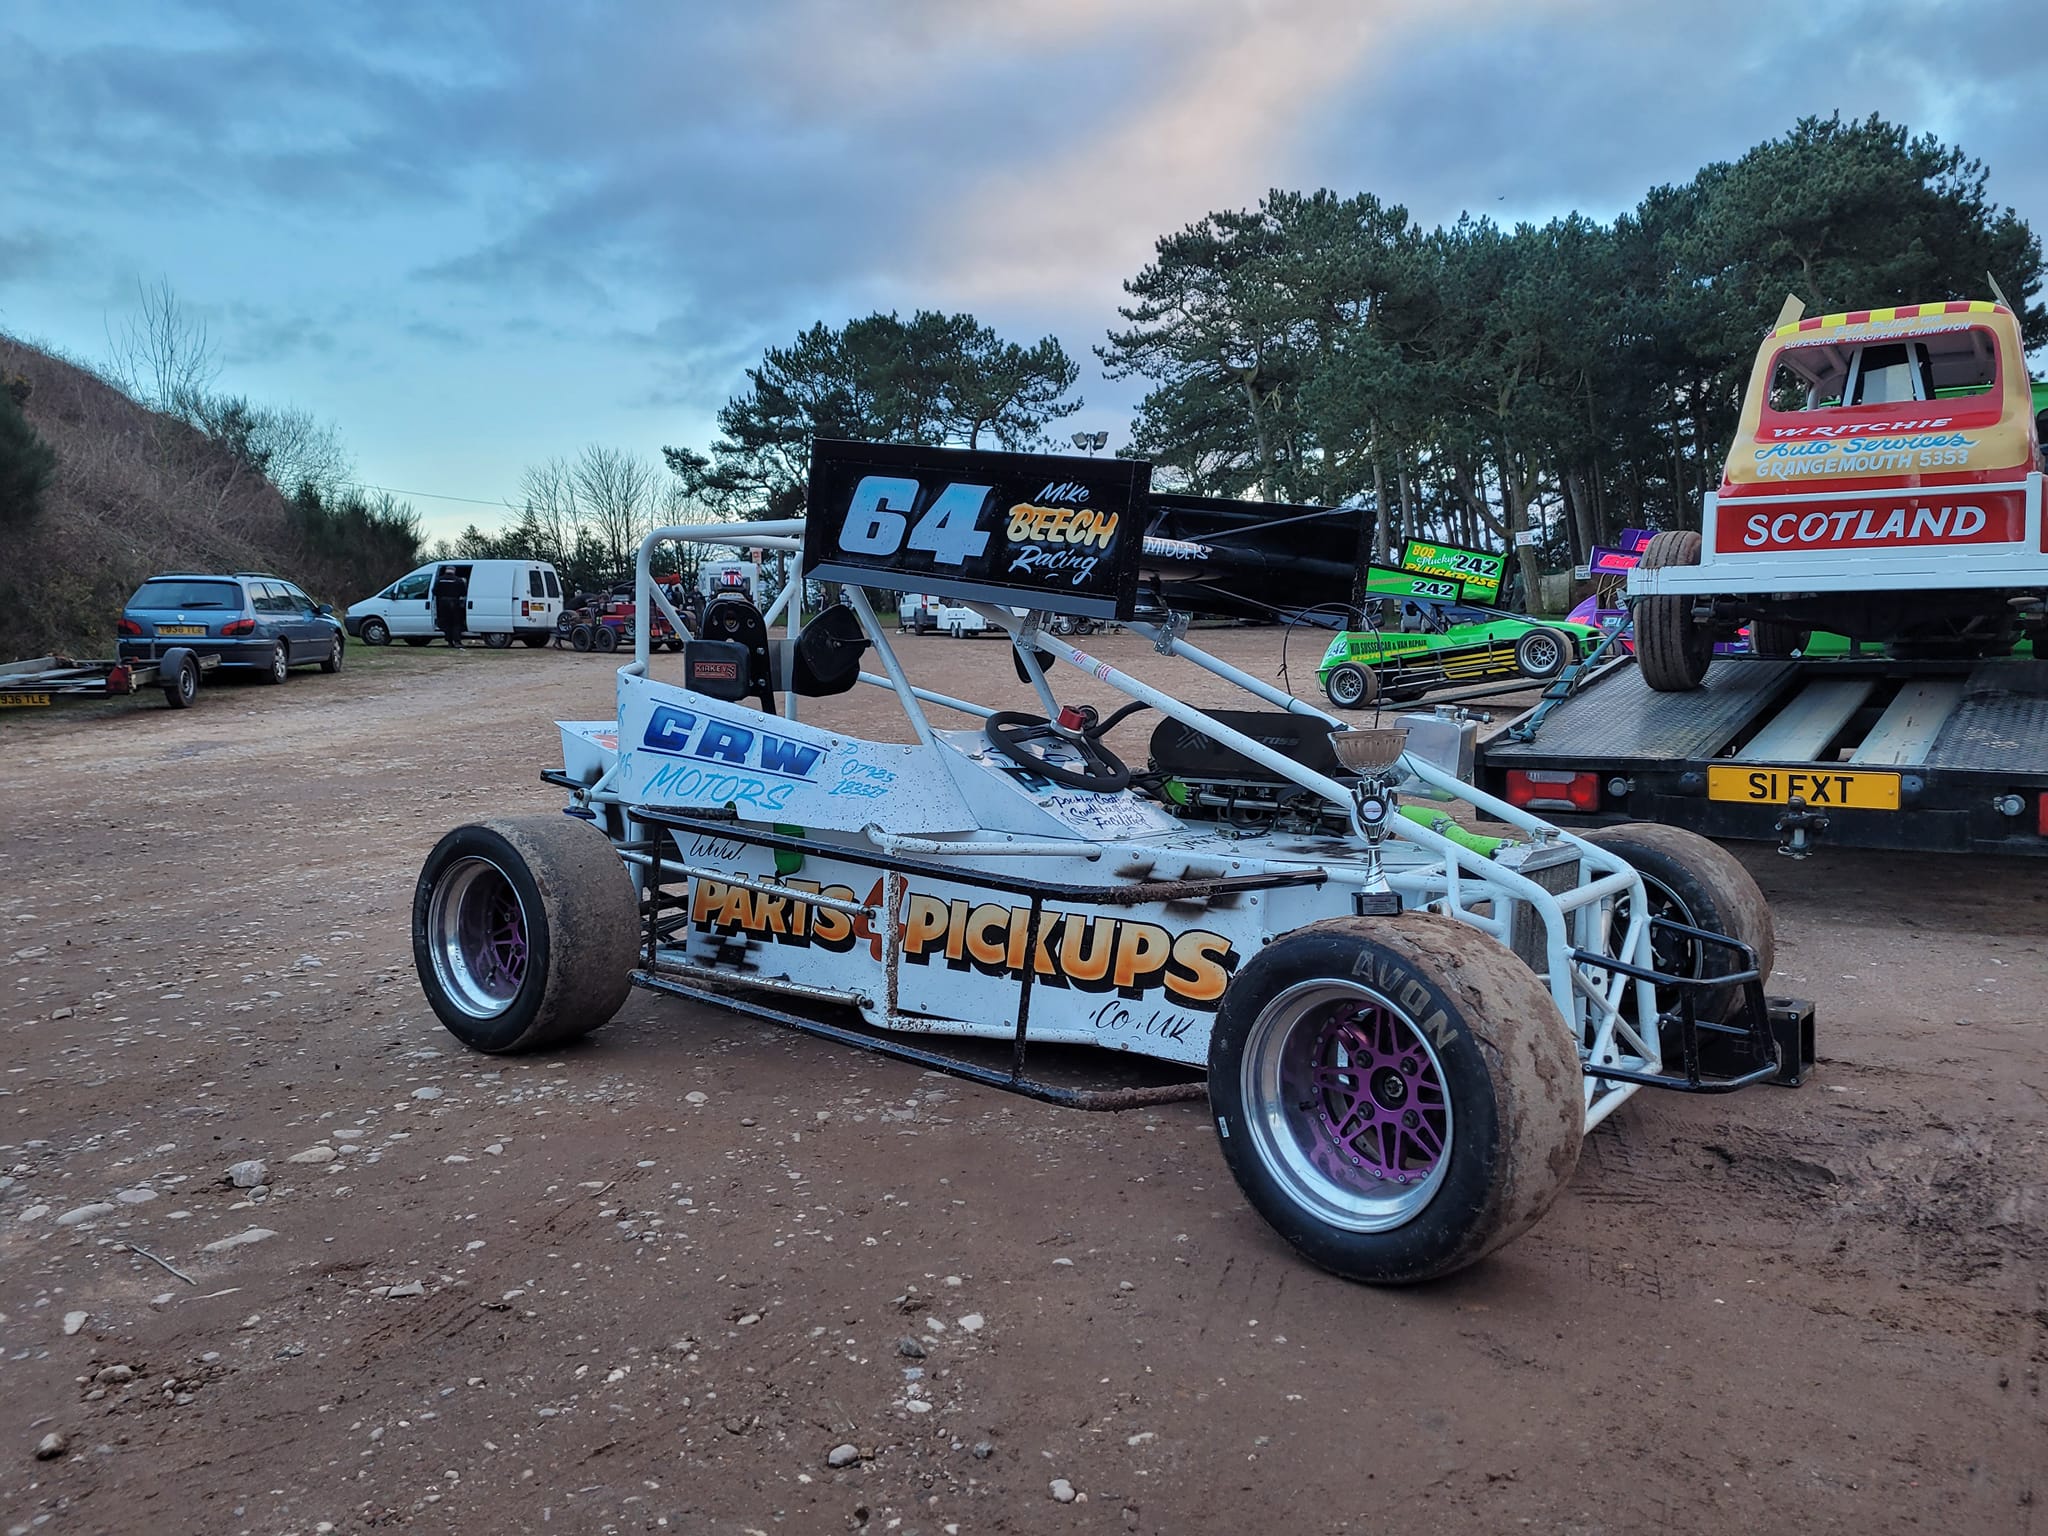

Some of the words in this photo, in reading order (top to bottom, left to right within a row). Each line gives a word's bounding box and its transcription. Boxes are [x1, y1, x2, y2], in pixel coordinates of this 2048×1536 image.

[1809, 418, 1953, 437] RITCHIE
[1754, 439, 1840, 462] Auto
[1842, 432, 1981, 455] Services
[1756, 454, 1913, 480] GRANGEMOUTH
[1919, 449, 1969, 467] 5353
[1034, 481, 1090, 503] Mike
[838, 475, 994, 566] 64
[1007, 502, 1119, 549] BEECH
[1743, 505, 1987, 547] SCOTLAND
[1145, 538, 1209, 560] MIDGETS
[1412, 544, 1436, 558] BOB
[1008, 545, 1099, 585] Racing
[1450, 554, 1500, 578] 242
[1411, 580, 1455, 598] 242
[1397, 639, 1409, 650] VAN
[643, 705, 822, 776] CRW
[641, 763, 796, 811] MOTORS
[1351, 950, 1459, 1050] AVON
